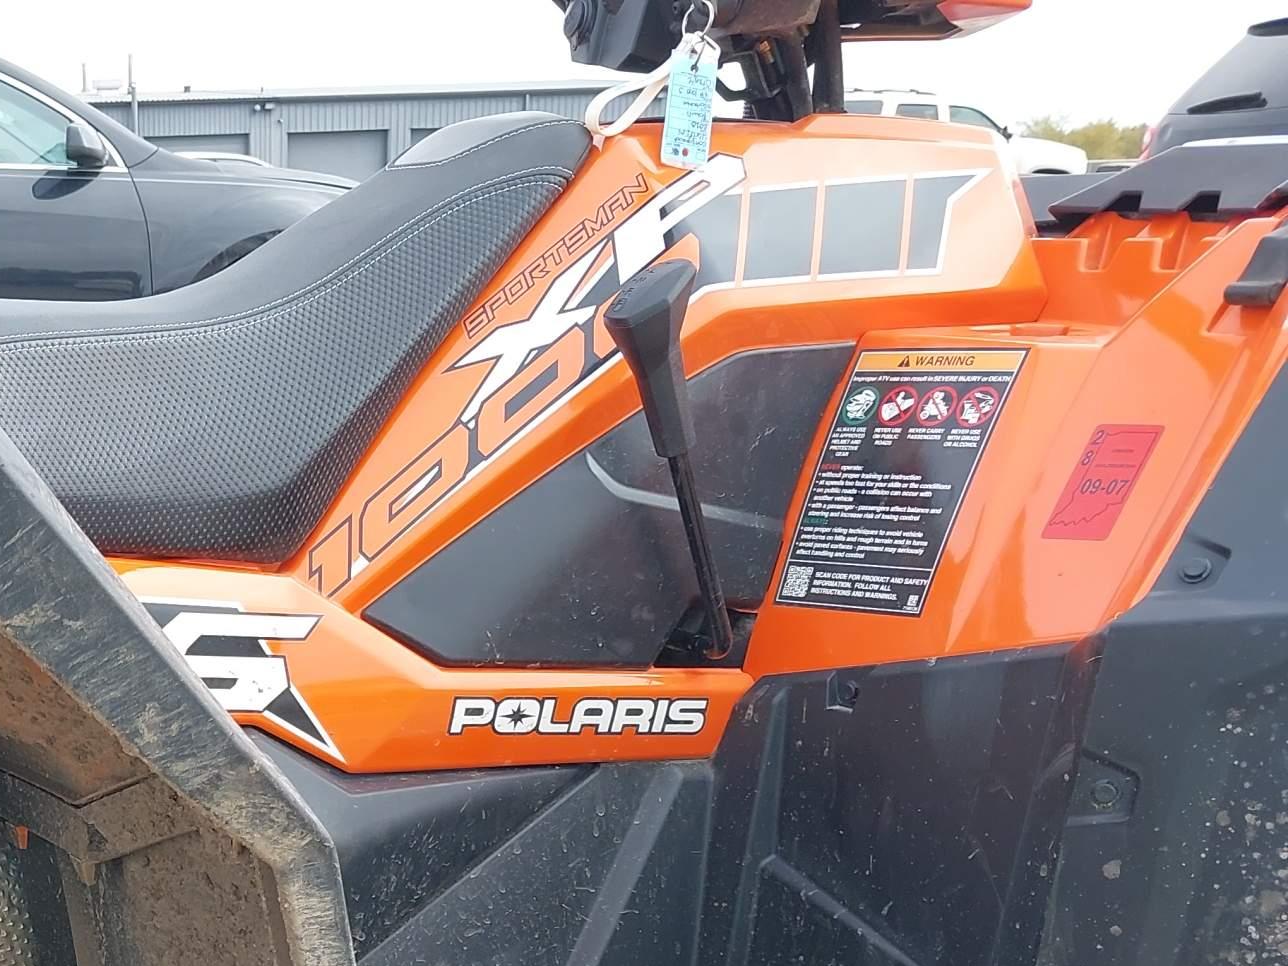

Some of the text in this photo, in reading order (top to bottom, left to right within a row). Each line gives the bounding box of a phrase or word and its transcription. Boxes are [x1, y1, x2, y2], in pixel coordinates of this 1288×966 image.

[462, 173, 649, 340] SPORTSMAN
[443, 152, 748, 432] XP
[914, 355, 975, 367] WARNING
[1080, 478, 1129, 495] 09-07
[831, 572, 849, 580] CODE
[861, 575, 890, 583] PRODUCT
[904, 578, 929, 586] SAFETY
[854, 582, 881, 591] FOLLOW
[810, 587, 852, 596] INSTRUCTIONS
[448, 696, 710, 736] POLARIS
